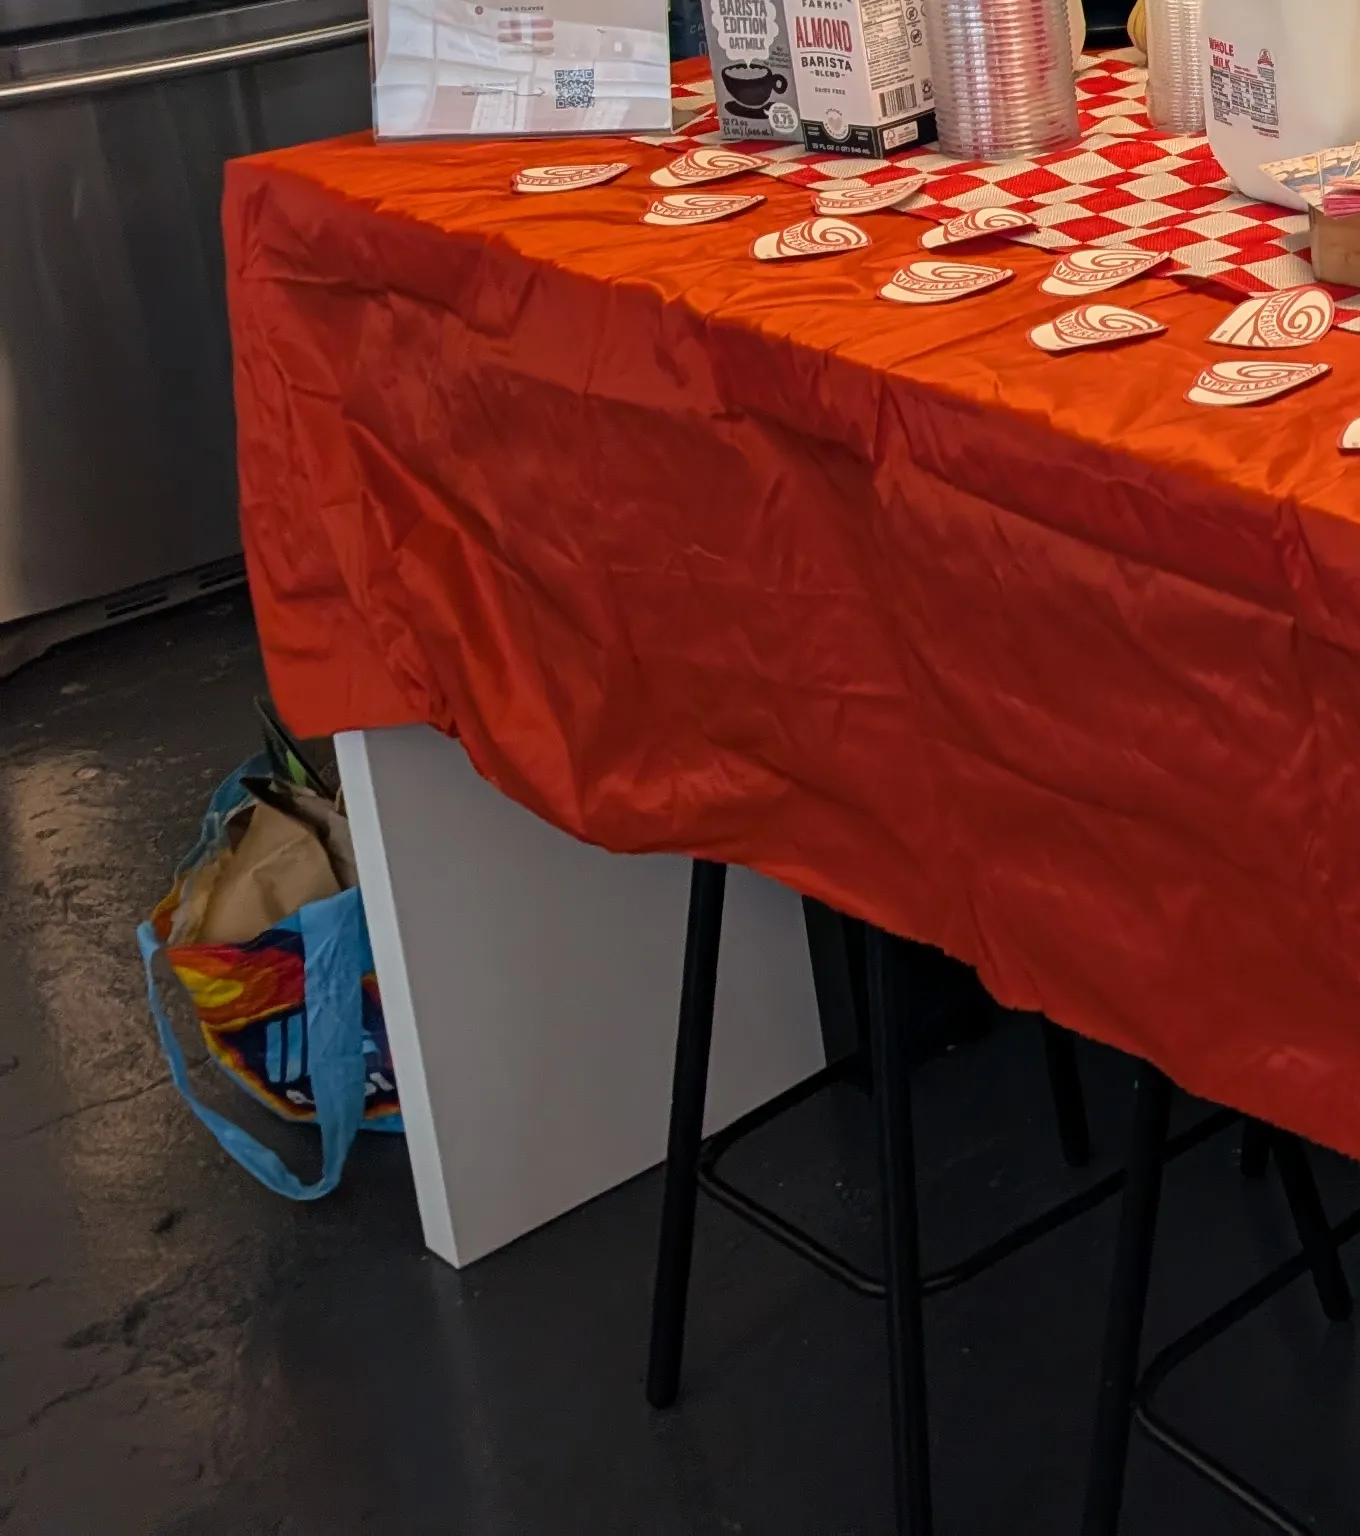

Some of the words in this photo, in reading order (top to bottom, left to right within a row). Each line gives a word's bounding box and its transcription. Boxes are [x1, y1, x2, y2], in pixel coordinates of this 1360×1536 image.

[723, 17, 768, 36] EDITION
[795, 15, 853, 53] ALMOND
[729, 36, 766, 51] OATMILK
[1209, 37, 1235, 58] WHOLE
[800, 56, 853, 73] BARISTA
